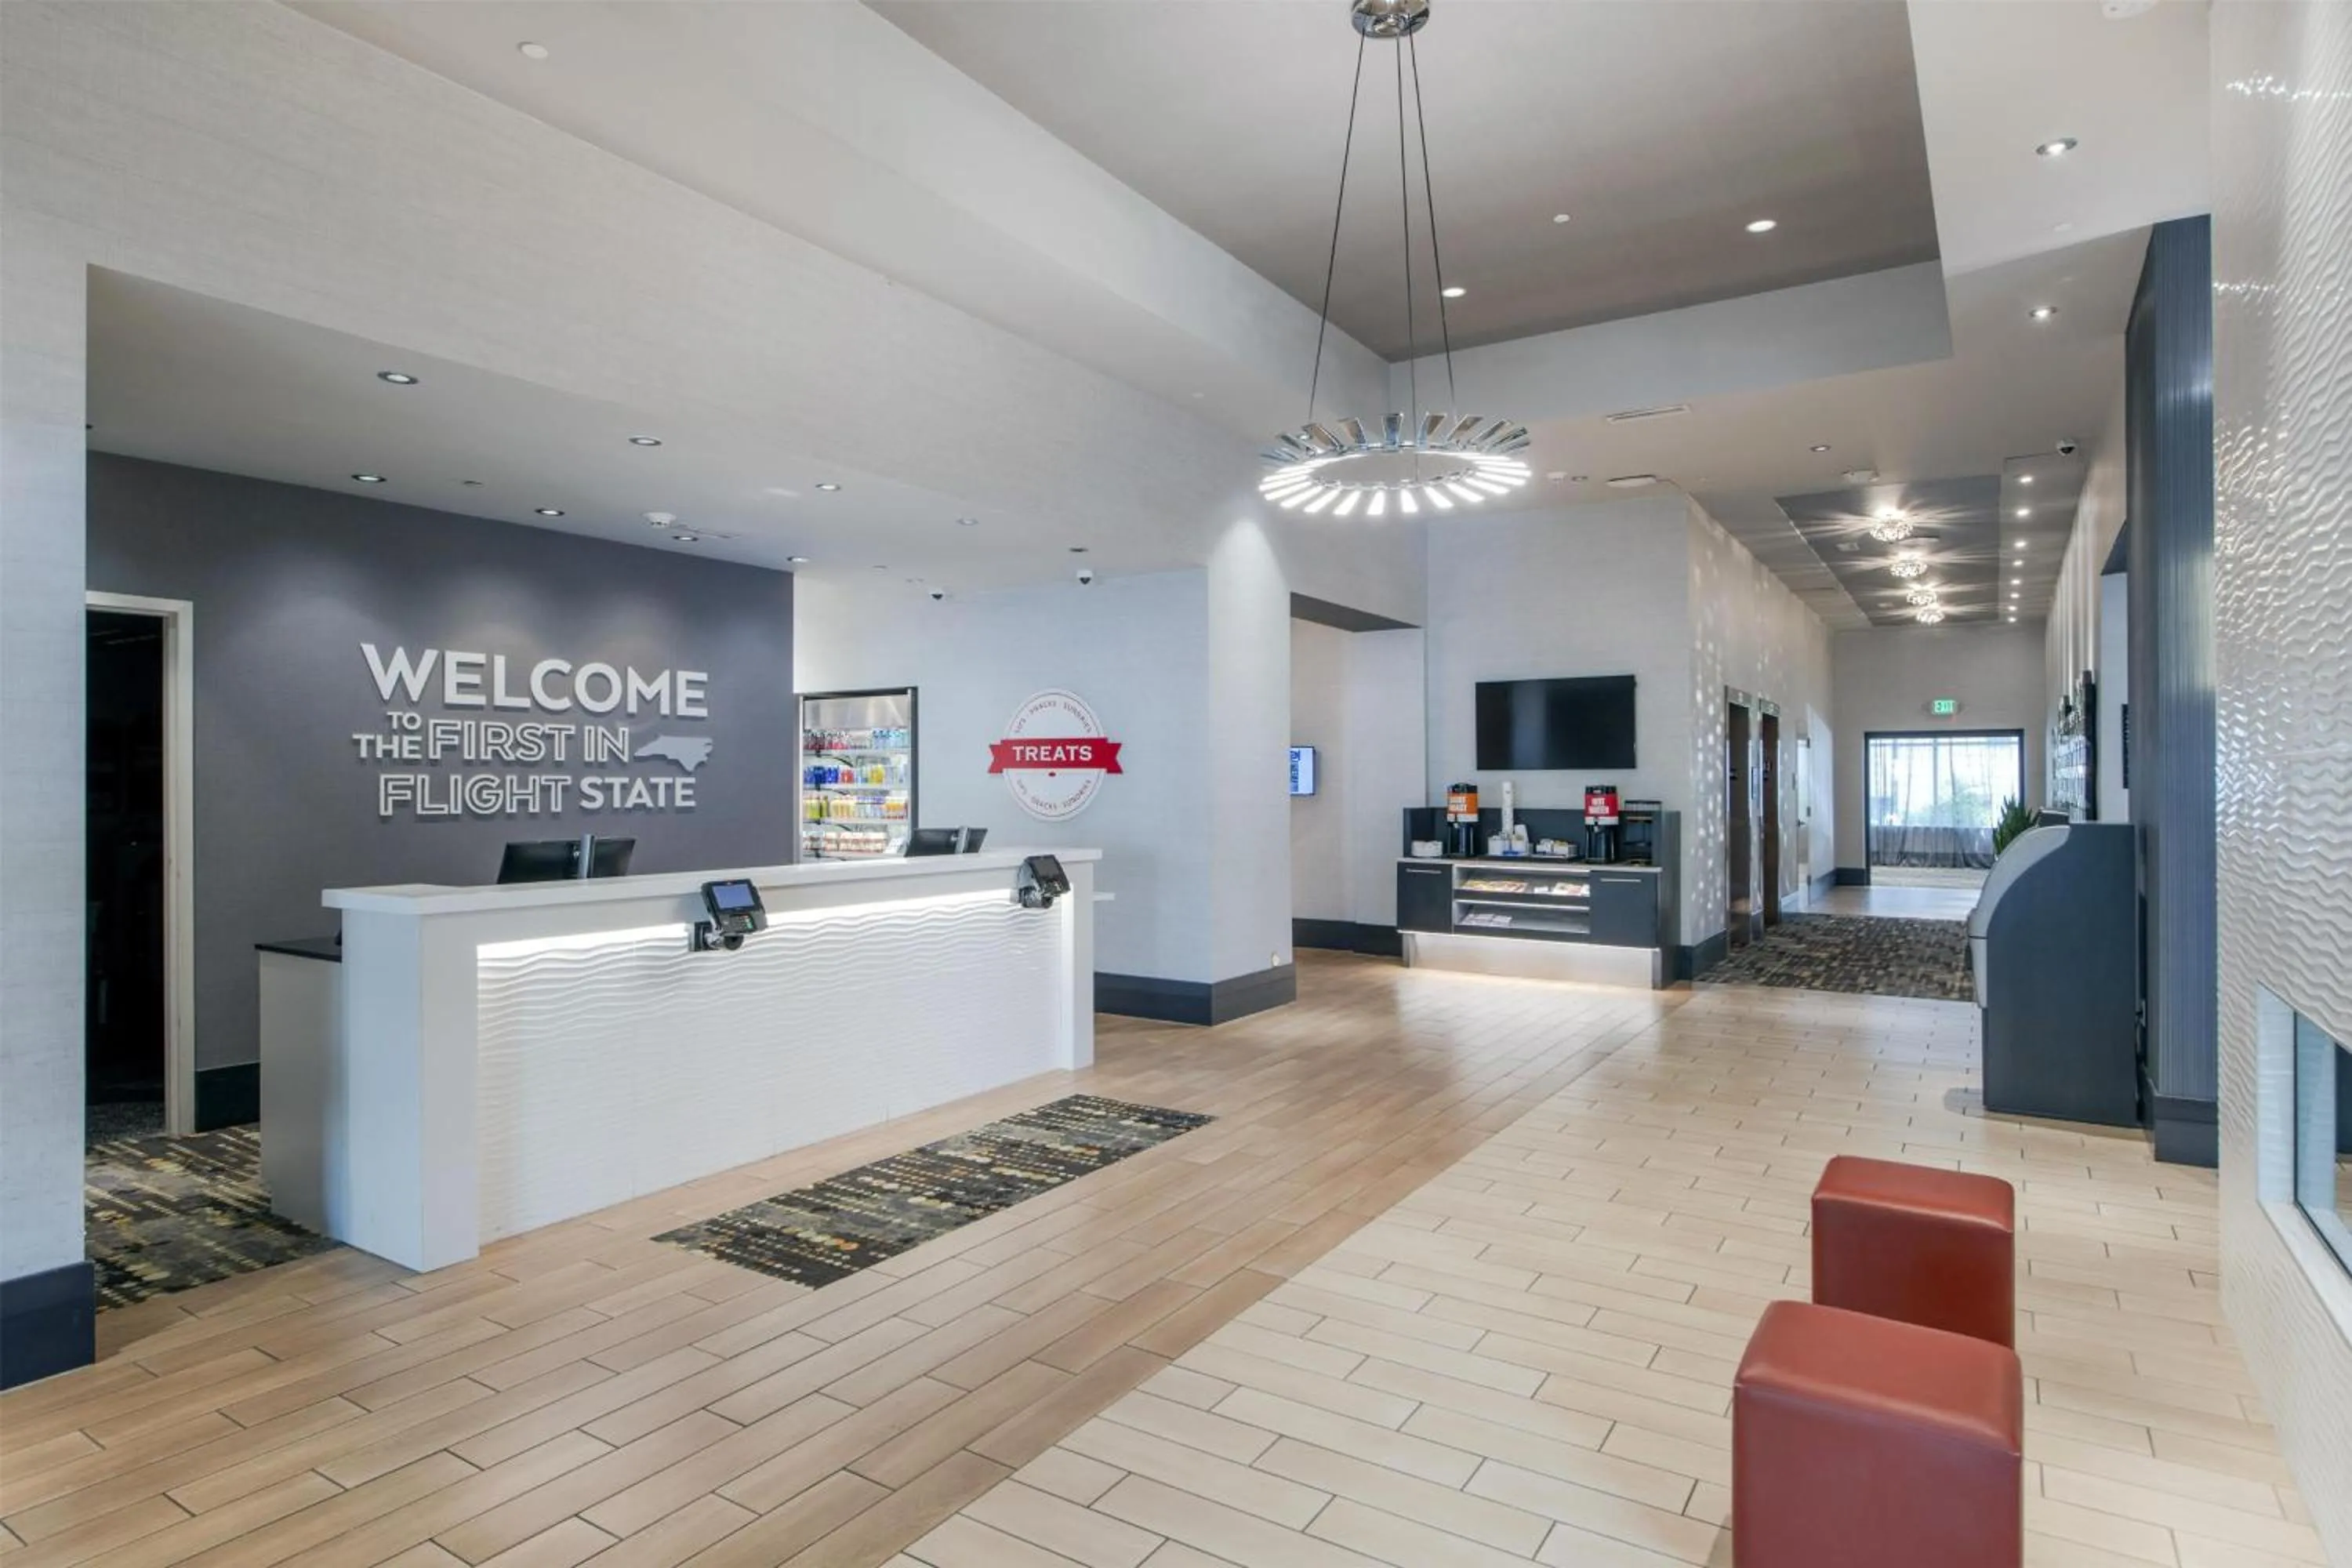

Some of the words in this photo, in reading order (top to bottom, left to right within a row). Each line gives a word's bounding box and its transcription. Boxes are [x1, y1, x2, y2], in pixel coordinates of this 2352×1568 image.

[360, 642, 709, 717] WELCOME
[387, 711, 421, 731] TO
[1934, 700, 1955, 713] EXIT
[351, 733, 423, 760] THE
[428, 718, 575, 762] FIRST
[583, 724, 630, 763] IN
[1012, 746, 1093, 762] TREATS
[379, 773, 572, 817] FLIGHT
[579, 776, 697, 810] STATE
